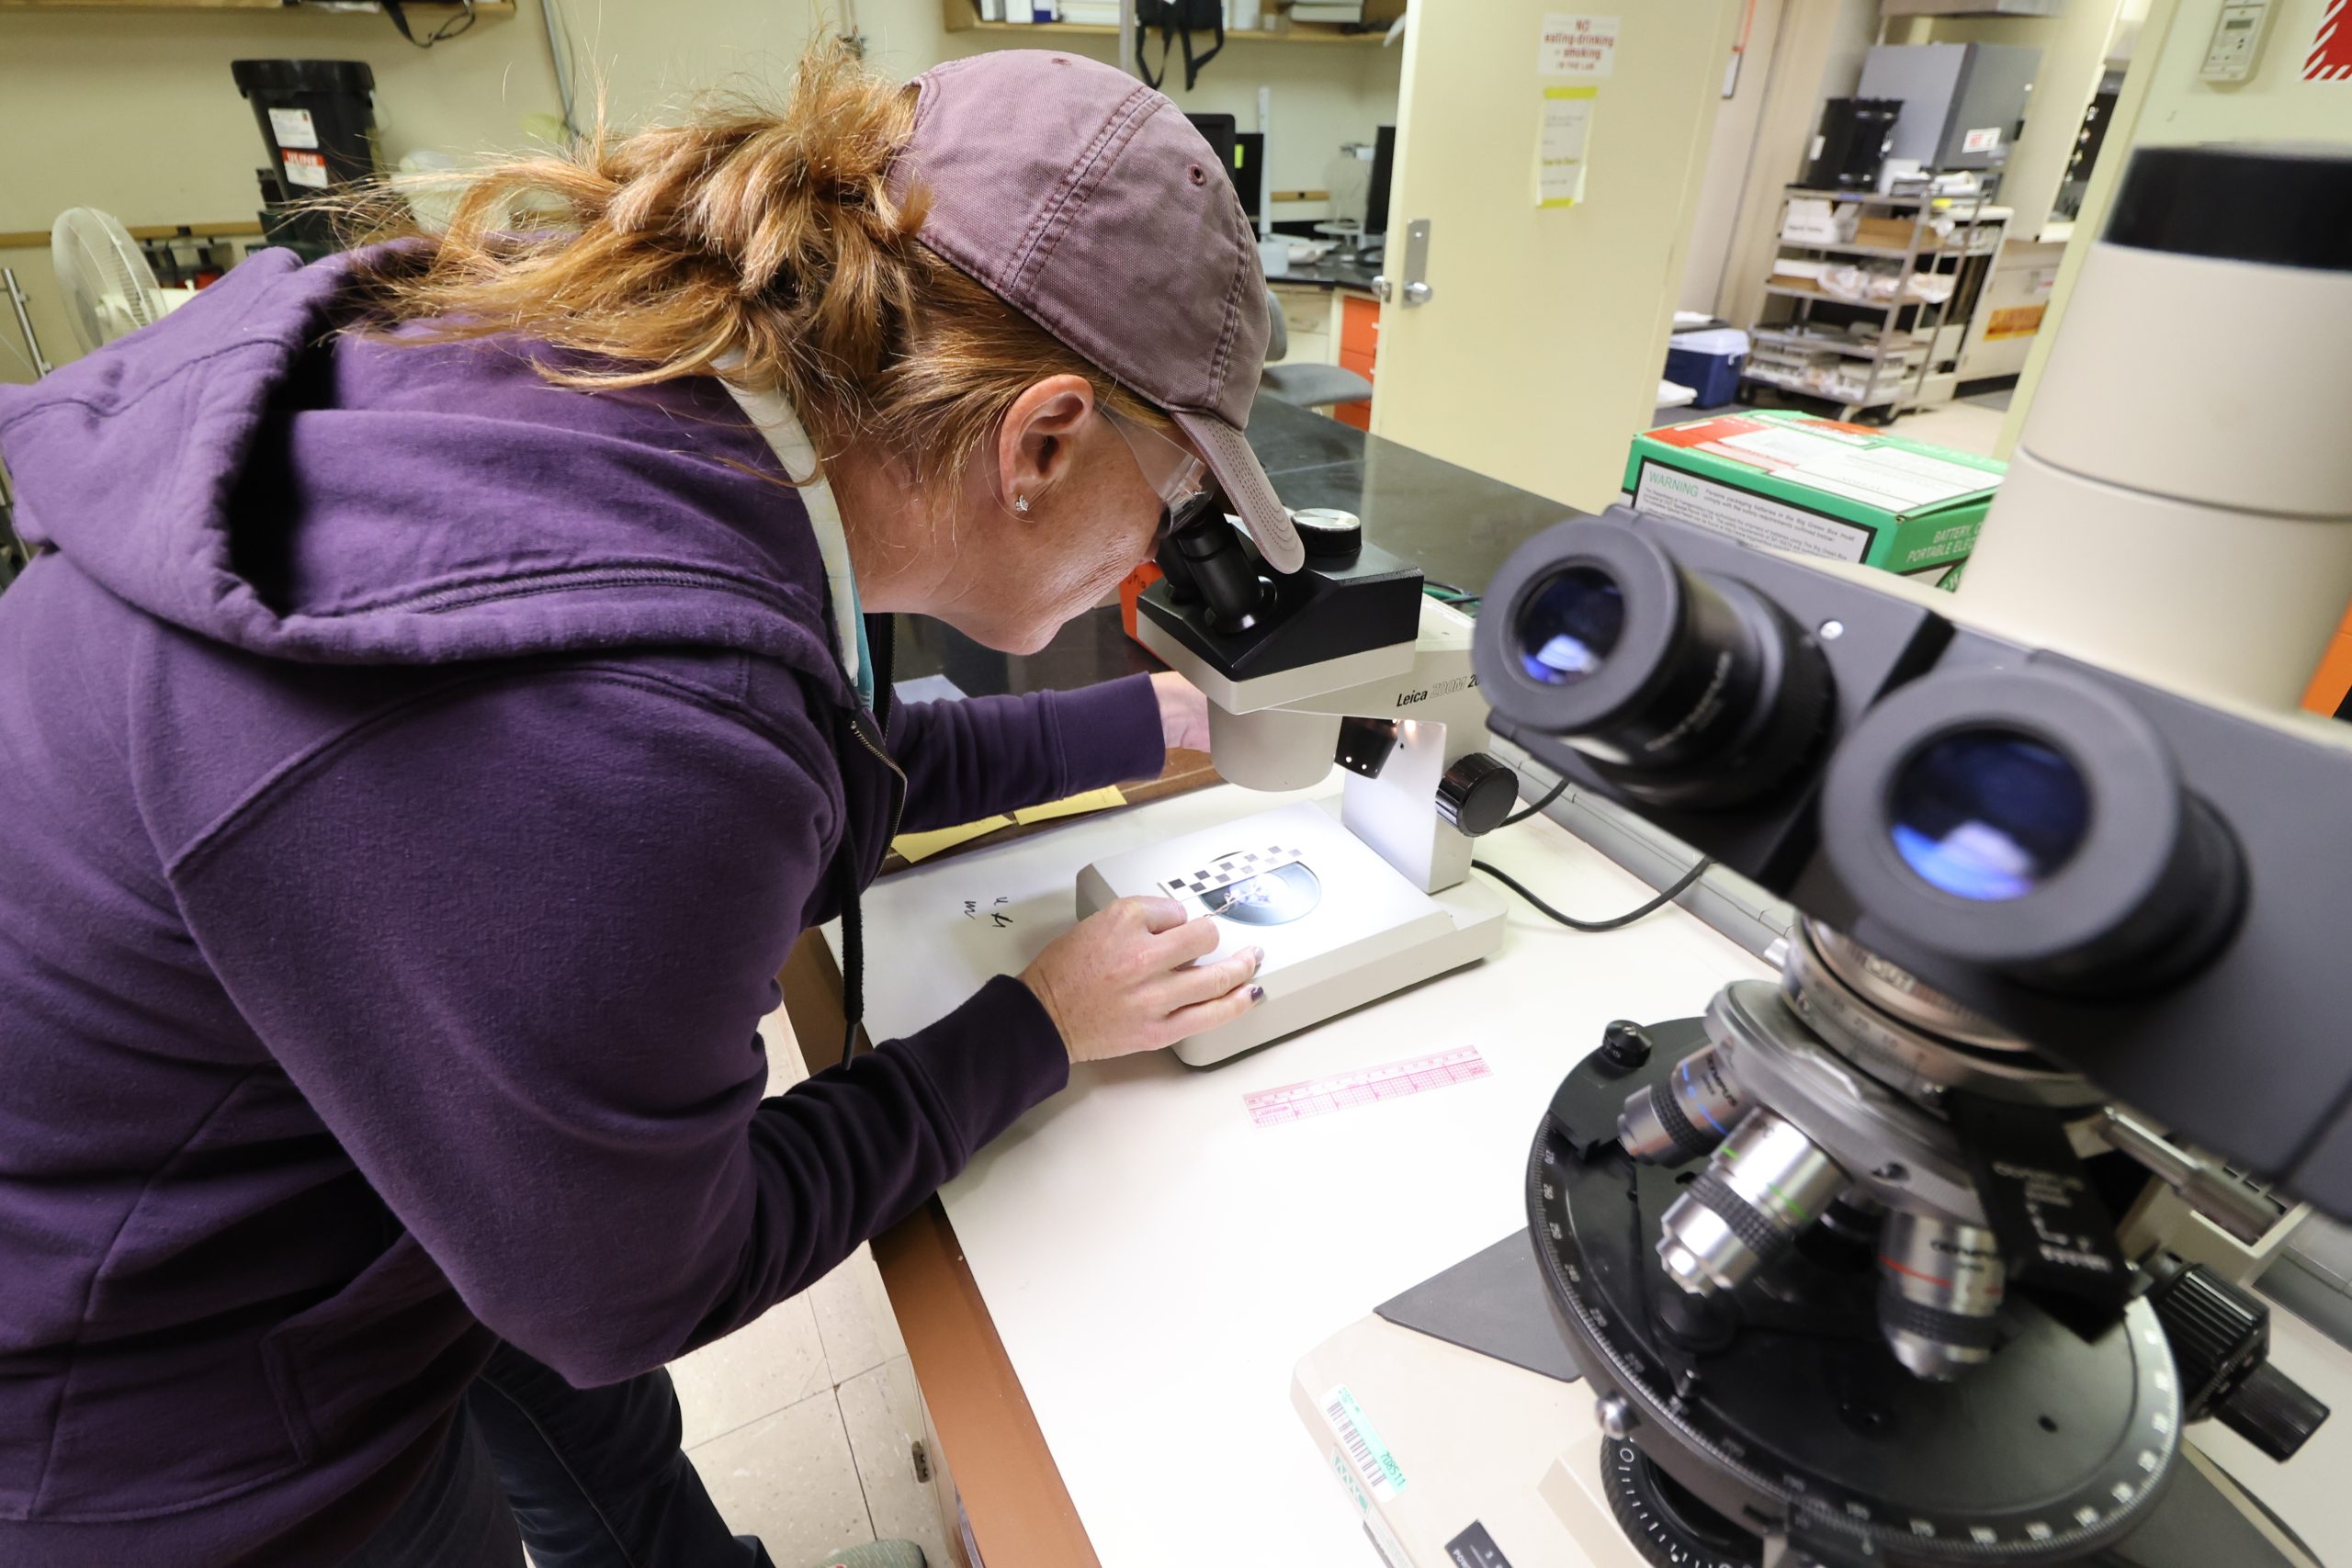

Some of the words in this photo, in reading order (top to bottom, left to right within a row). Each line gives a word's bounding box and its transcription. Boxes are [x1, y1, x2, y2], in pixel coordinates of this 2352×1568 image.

[1576, 19, 1589, 31] NO
[1565, 49, 1601, 60] smoking
[1649, 471, 1699, 497] WARNING
[1905, 543, 1951, 563] PORTABLE
[1396, 690, 1429, 707] Leica
[1429, 675, 1468, 699] ZOOM
